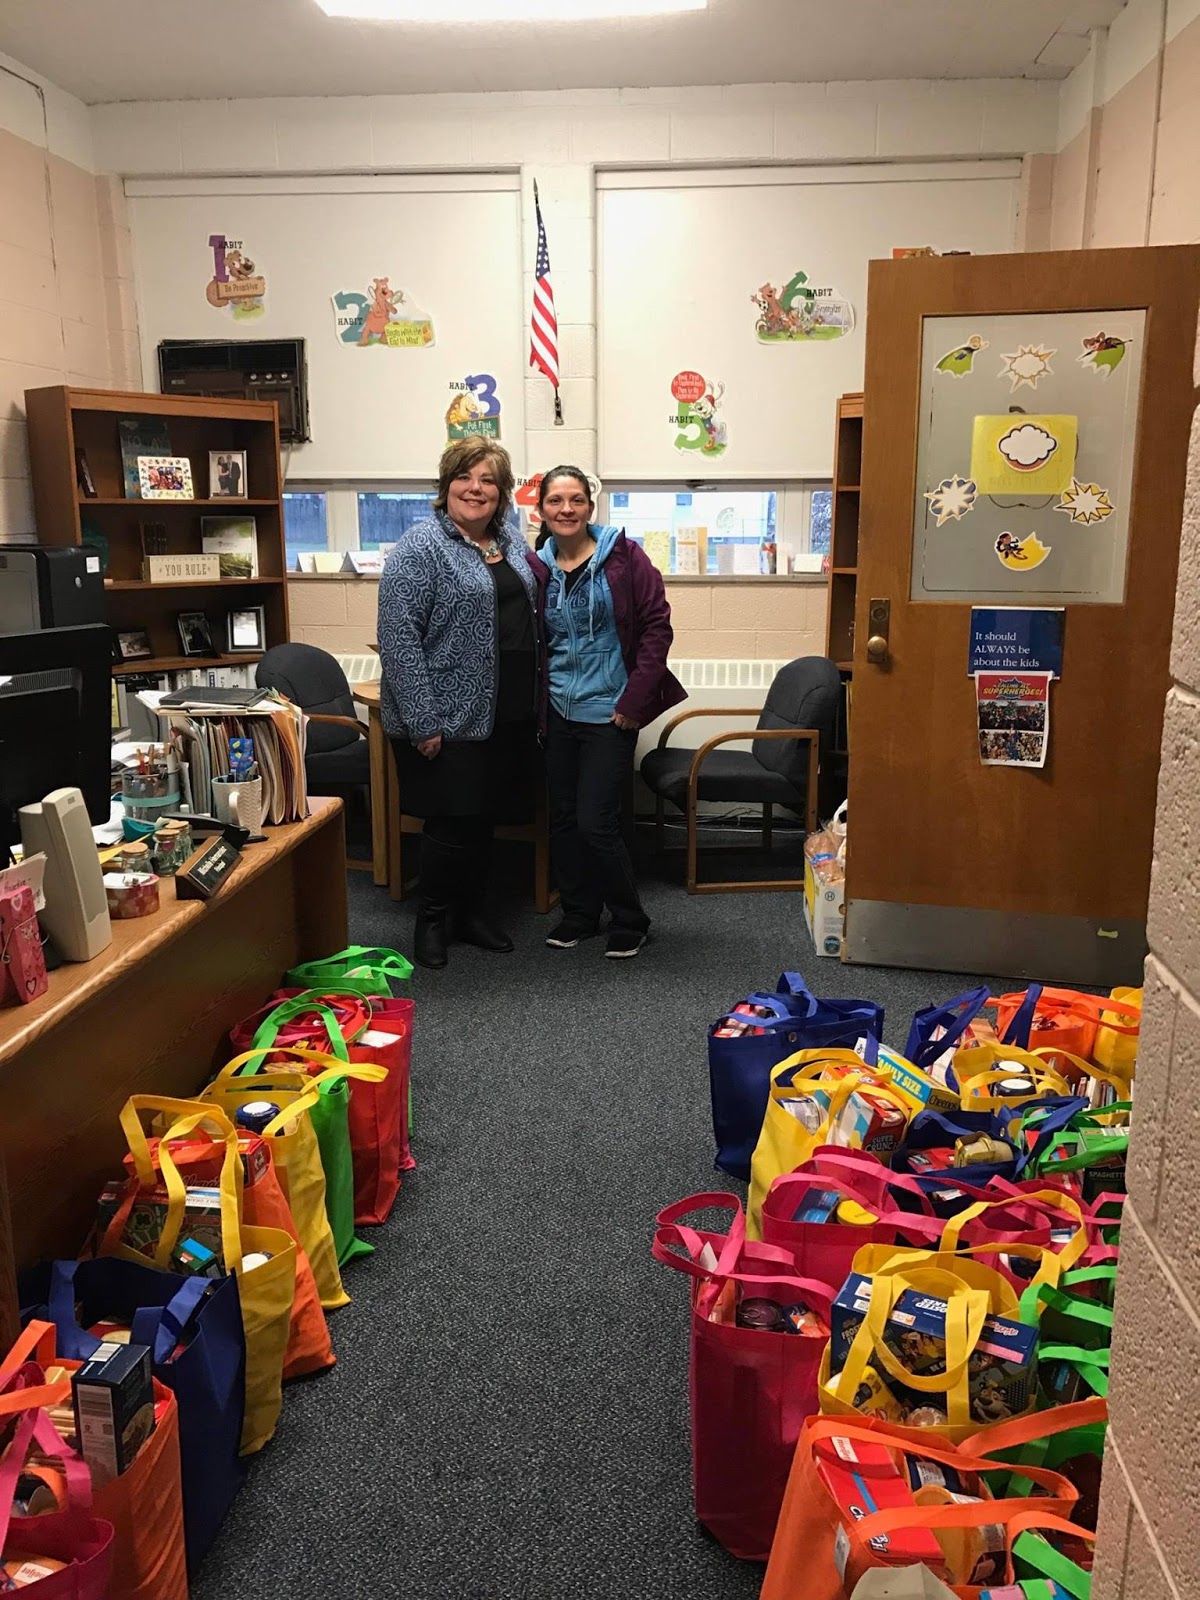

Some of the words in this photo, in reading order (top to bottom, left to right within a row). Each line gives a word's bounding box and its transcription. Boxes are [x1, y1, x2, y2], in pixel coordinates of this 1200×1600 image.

[219, 241, 243, 249] HABIT
[806, 288, 833, 297] HABIT
[337, 317, 364, 326] HABIT
[449, 381, 475, 391] HABIT
[669, 415, 695, 424] HABIT
[517, 478, 542, 487] HABIT
[165, 564, 182, 576] YOU
[185, 563, 207, 576] RULE
[975, 631, 983, 640] It
[984, 631, 1017, 641] should
[974, 645, 1016, 654] ALWAYS
[1018, 645, 1031, 655] be
[973, 657, 1000, 667] about
[1002, 657, 1018, 667] the
[1020, 658, 1040, 668] kids
[982, 687, 1044, 696] SUPERHEROES!
[877, 1056, 903, 1083] AMILY
[901, 1075, 923, 1096] SIZE
[929, 1093, 959, 1111] Cheerios
[872, 1134, 894, 1144] SUPER
[865, 1141, 903, 1152] CRUNCH
